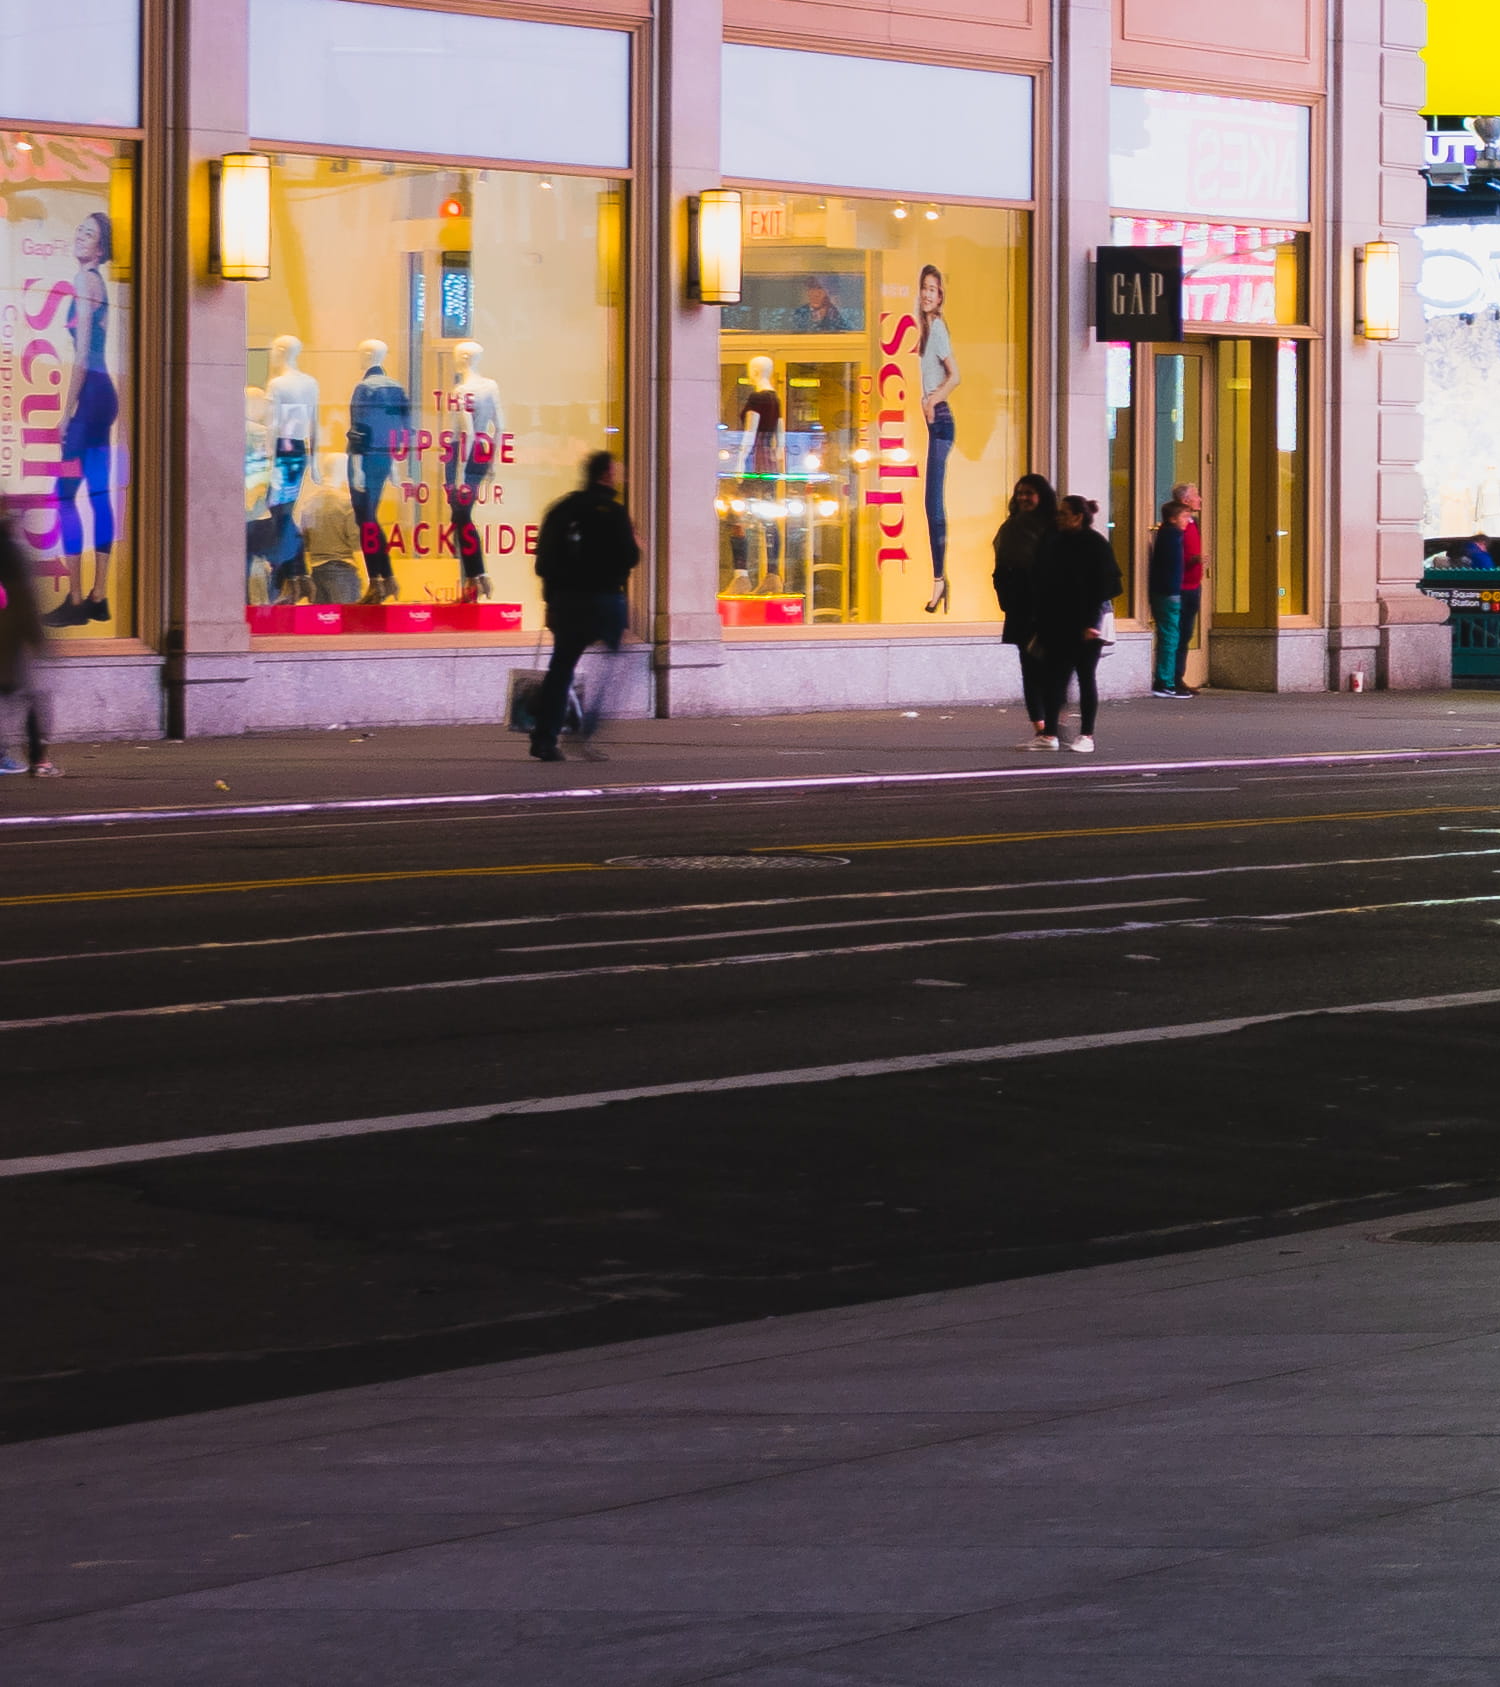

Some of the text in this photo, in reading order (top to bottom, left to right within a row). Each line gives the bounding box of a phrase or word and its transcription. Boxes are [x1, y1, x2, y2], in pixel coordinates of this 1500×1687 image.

[750, 209, 783, 238] EXIT
[1111, 271, 1164, 316] GAP
[432, 390, 477, 413] THE
[388, 429, 516, 464] UPSIDE
[865, 312, 921, 575] Sculpt
[401, 482, 504, 505] TO YOUR
[359, 521, 540, 556] BACKSIDE
